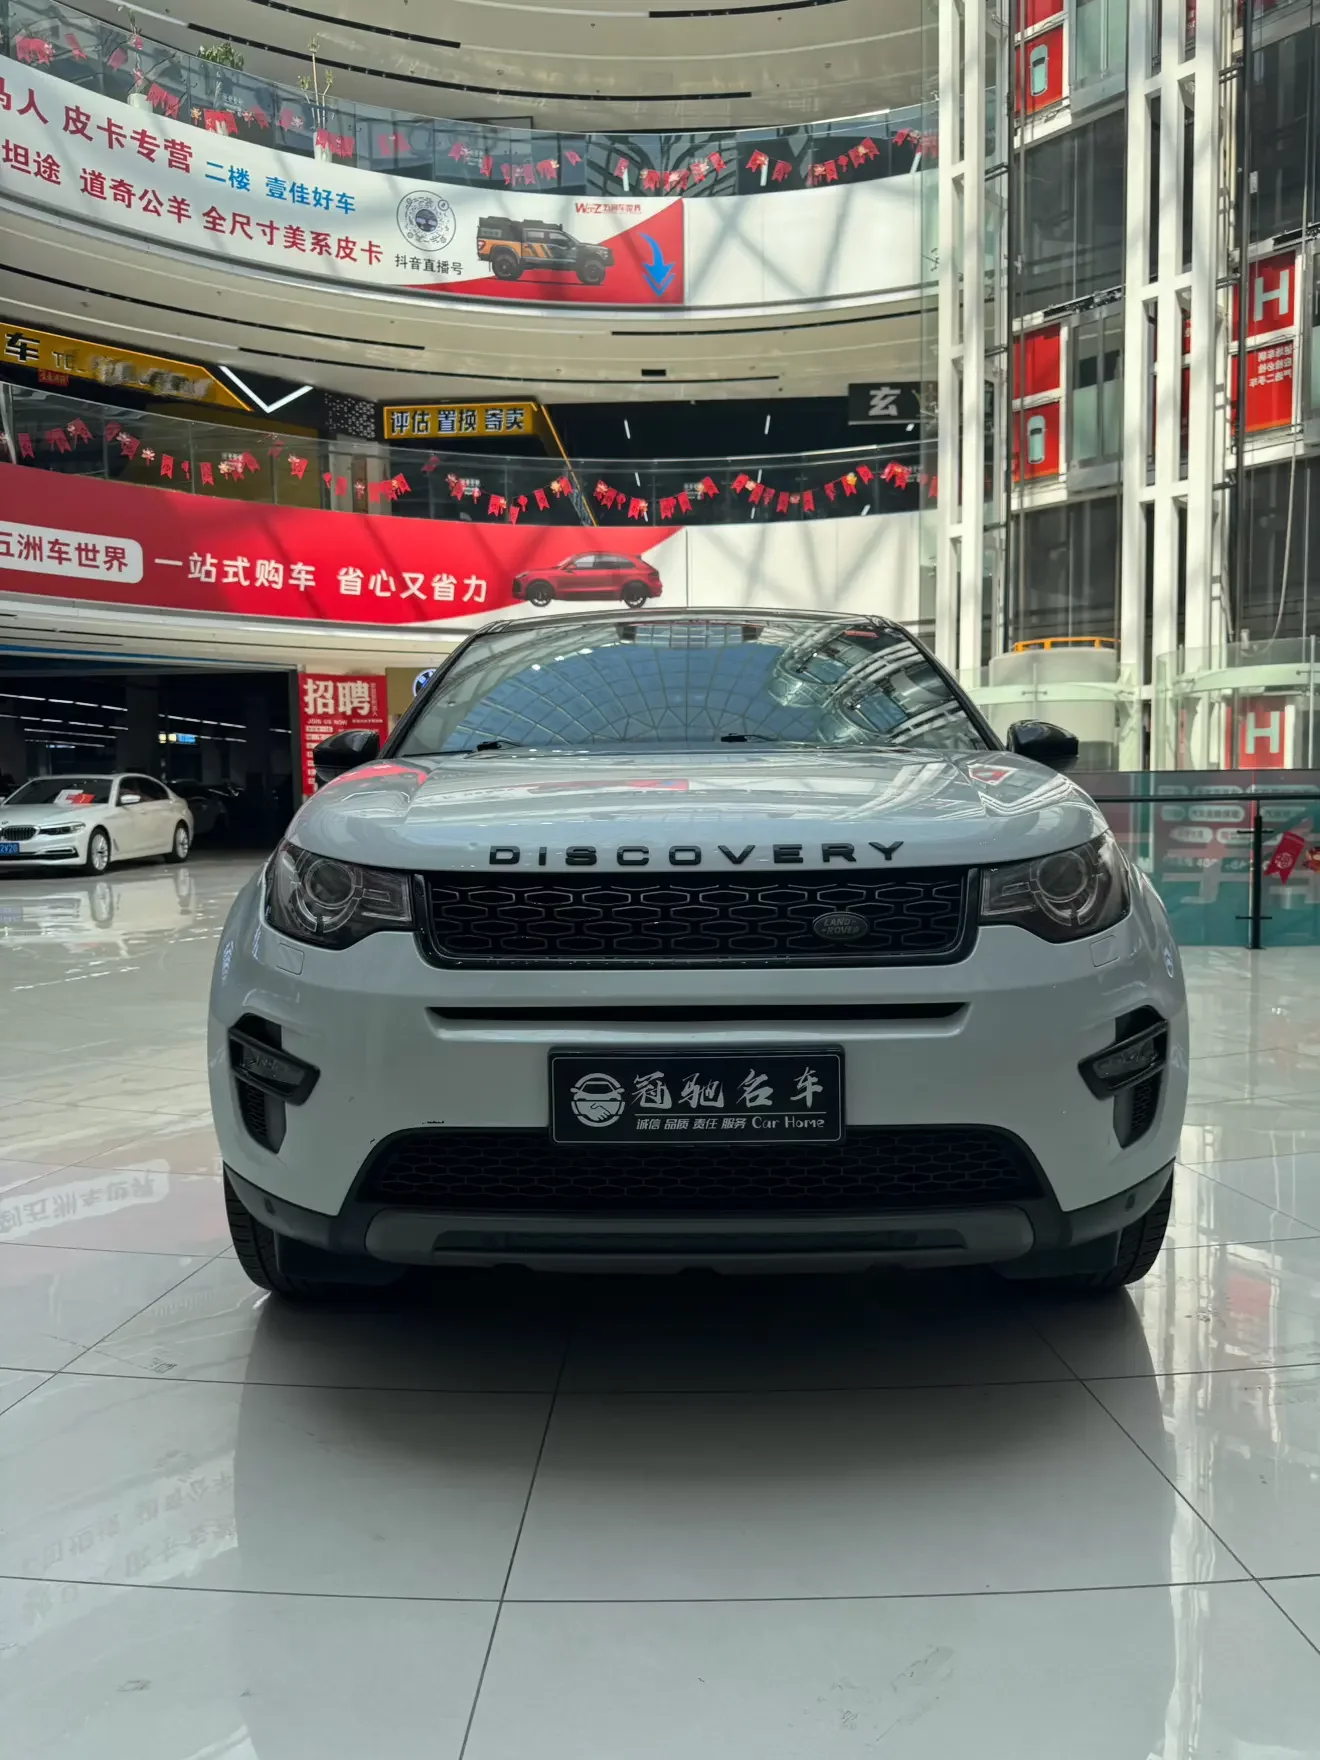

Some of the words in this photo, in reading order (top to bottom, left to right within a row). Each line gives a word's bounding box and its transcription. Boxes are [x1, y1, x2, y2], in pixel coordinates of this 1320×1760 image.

[63, 105, 193, 174] 皮卡专营
[205, 161, 251, 192] 二楼
[265, 176, 356, 215] 壹佳好车
[2, 139, 61, 185] 坦途
[79, 168, 192, 224] 道奇公羊
[202, 206, 384, 266] 全尺寸美系皮卡
[394, 254, 464, 275] 抖音直播号
[4, 332, 40, 363] 车
[868, 386, 901, 416] 玄
[391, 410, 431, 436] 评估
[437, 409, 478, 434] 置换
[485, 407, 525, 433] 寄卖
[154, 552, 316, 591] 一站式购车
[337, 566, 488, 604] 省心又省力
[303, 679, 370, 715] 招聘
[489, 841, 904, 867] DISCOVERY
[630, 1066, 824, 1109] 冠驰名车
[636, 1118, 661, 1130] 诚信
[664, 1118, 690, 1130] 品质
[692, 1118, 718, 1130] 责任
[721, 1117, 748, 1130] 服务
[751, 1116, 778, 1129] Car
[784, 1115, 825, 1128] Home
